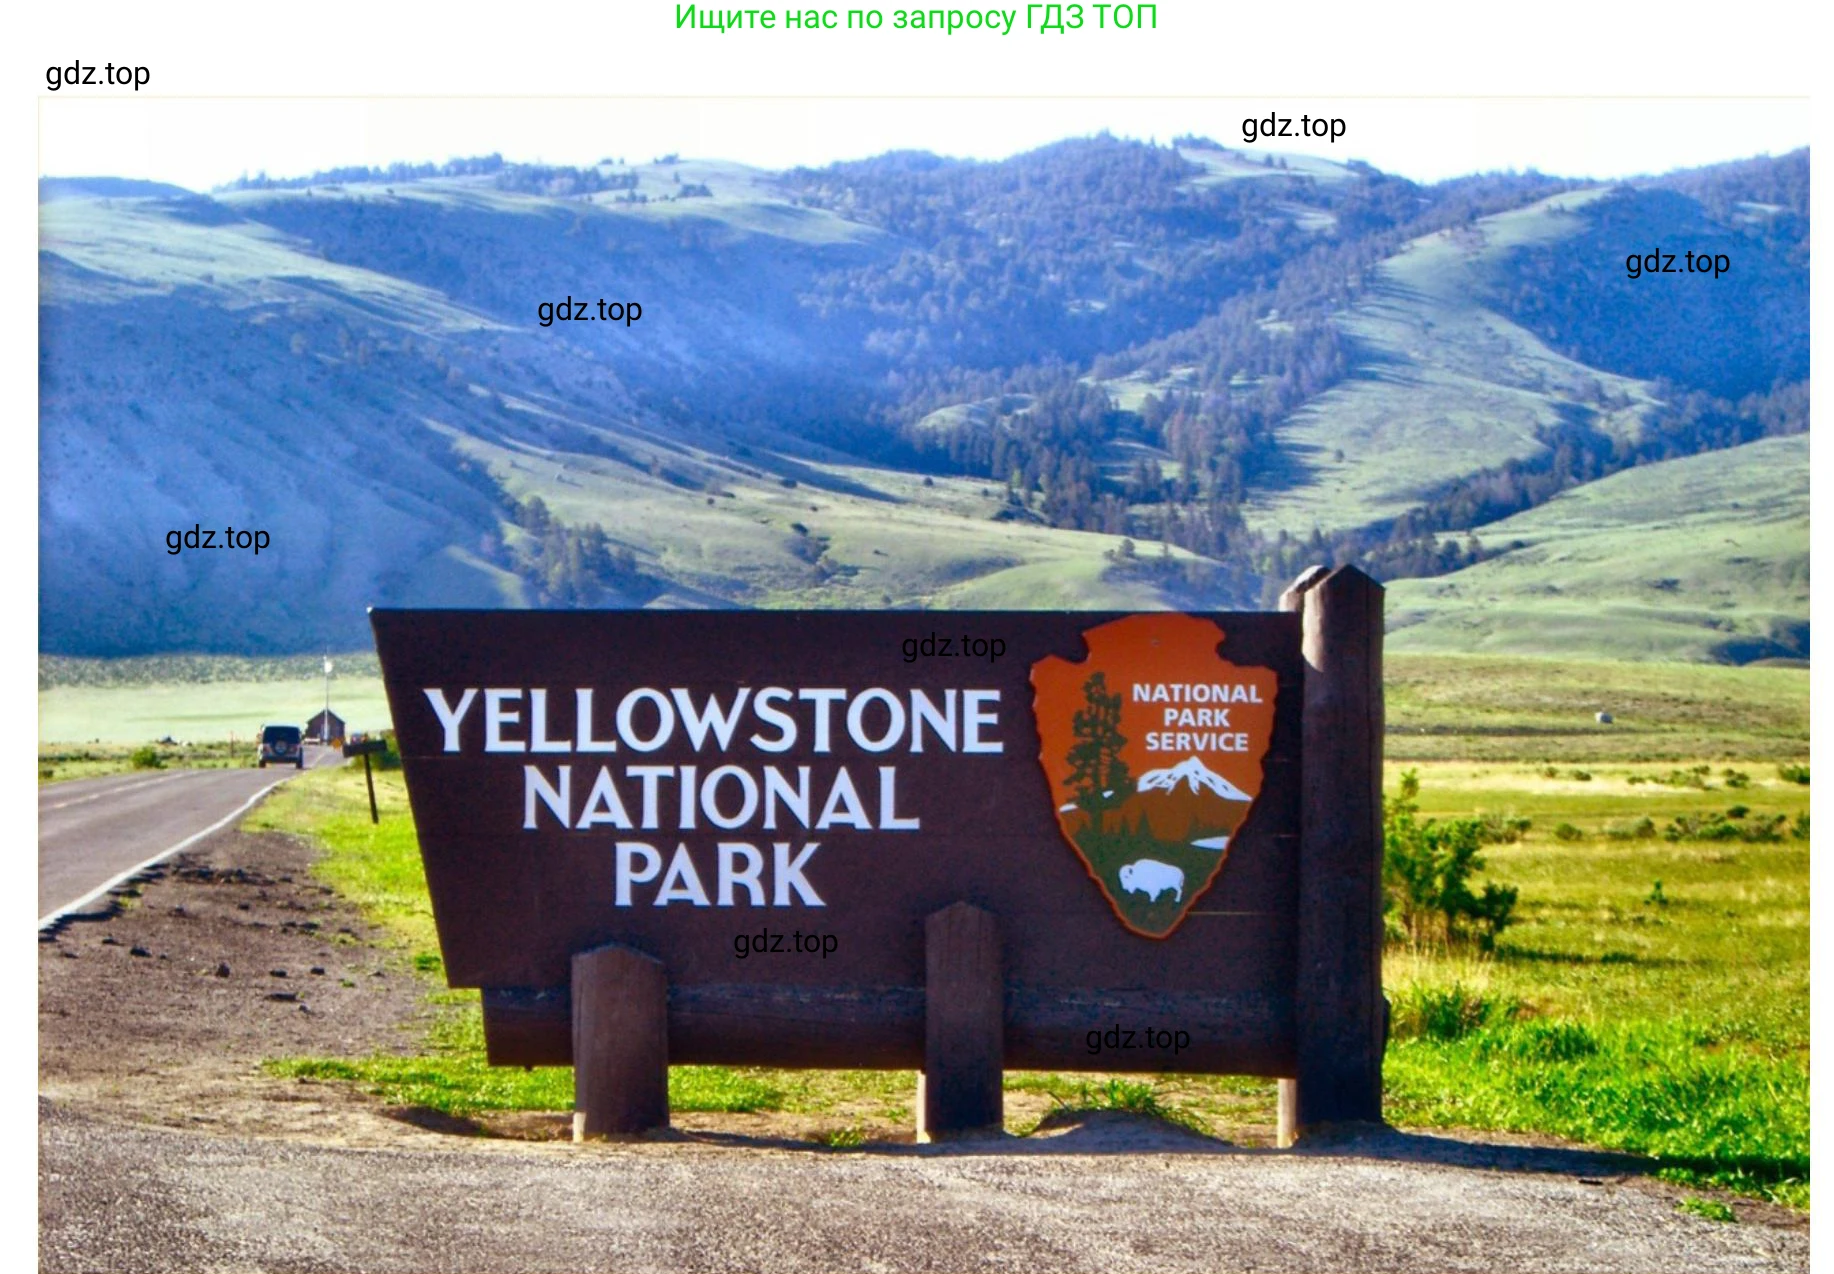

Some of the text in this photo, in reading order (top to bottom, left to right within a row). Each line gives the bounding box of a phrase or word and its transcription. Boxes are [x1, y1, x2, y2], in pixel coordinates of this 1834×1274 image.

[1132, 683, 1263, 704] NATIONAL
[422, 686, 1004, 754] YELLOWSTONE
[1163, 708, 1231, 728] PARK
[1145, 732, 1249, 752] SERVICE
[523, 764, 920, 830] NATIONAL
[614, 842, 826, 907] PARK
